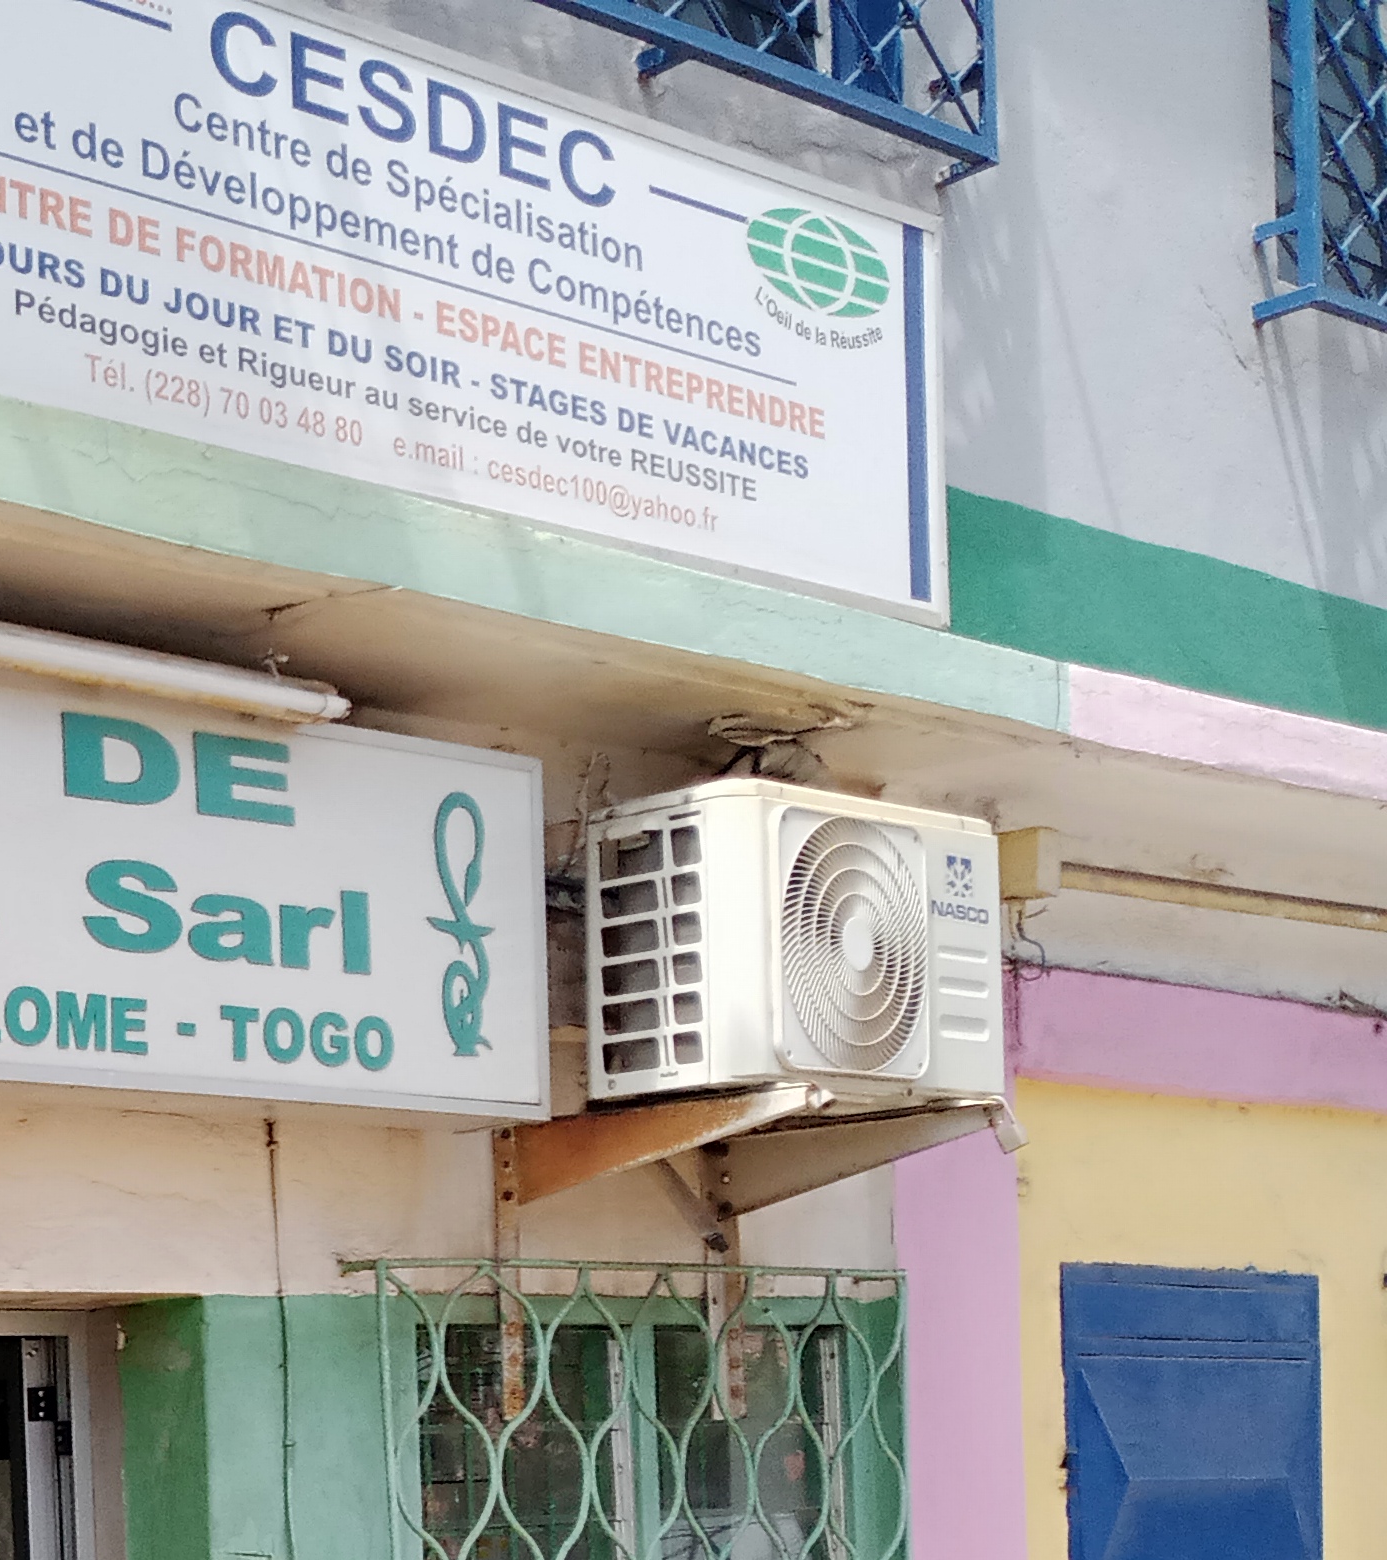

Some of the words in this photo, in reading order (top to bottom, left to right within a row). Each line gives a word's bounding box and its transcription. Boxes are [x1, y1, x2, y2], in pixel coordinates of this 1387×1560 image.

[173, 91, 312, 169] Centre
[325, 141, 373, 187] de
[385, 158, 644, 273] Spécialisation
[209, 10, 617, 209] CESDEC
[14, 110, 58, 151] et
[70, 121, 125, 169] de
[140, 137, 460, 270] Développement
[470, 242, 516, 285] de
[527, 257, 762, 358] Compétences
[108, 207, 161, 257] DE
[175, 225, 401, 323] FORMATION
[436, 299, 567, 369] ESPACE
[578, 341, 826, 440] ENTREPRENDRE
[754, 285, 793, 330] L'Oeil
[795, 320, 812, 341] de
[815, 326, 827, 346] la
[830, 326, 884, 350] Réussite
[14, 287, 189, 358] Pédagogie
[198, 341, 228, 369] et
[237, 345, 357, 399] Rigueur
[364, 385, 399, 411] au
[406, 396, 508, 439] service
[515, 420, 548, 449] de
[555, 434, 623, 469] votre
[630, 447, 758, 502] REUSSITE
[84, 353, 135, 393] Tél.
[144, 368, 211, 418] (228)
[218, 386, 250, 420] 70
[258, 396, 288, 429] 03
[296, 407, 326, 438] 48
[334, 415, 363, 447] 80
[392, 437, 464, 472] e.mail
[487, 459, 719, 531] cesdec100@yahoo.fr
[99, 265, 150, 307] DU
[162, 286, 262, 337] JOUR
[272, 313, 316, 349] ET
[326, 327, 373, 365] DU
[383, 343, 462, 390] SOIR
[488, 372, 608, 427] STAGES
[616, 405, 655, 441] DE
[662, 418, 810, 480] VACANCES
[63, 713, 295, 824] DE
[83, 859, 371, 975] Sarl
[930, 899, 990, 925] NASCO
[220, 1004, 395, 1070] TOGO
